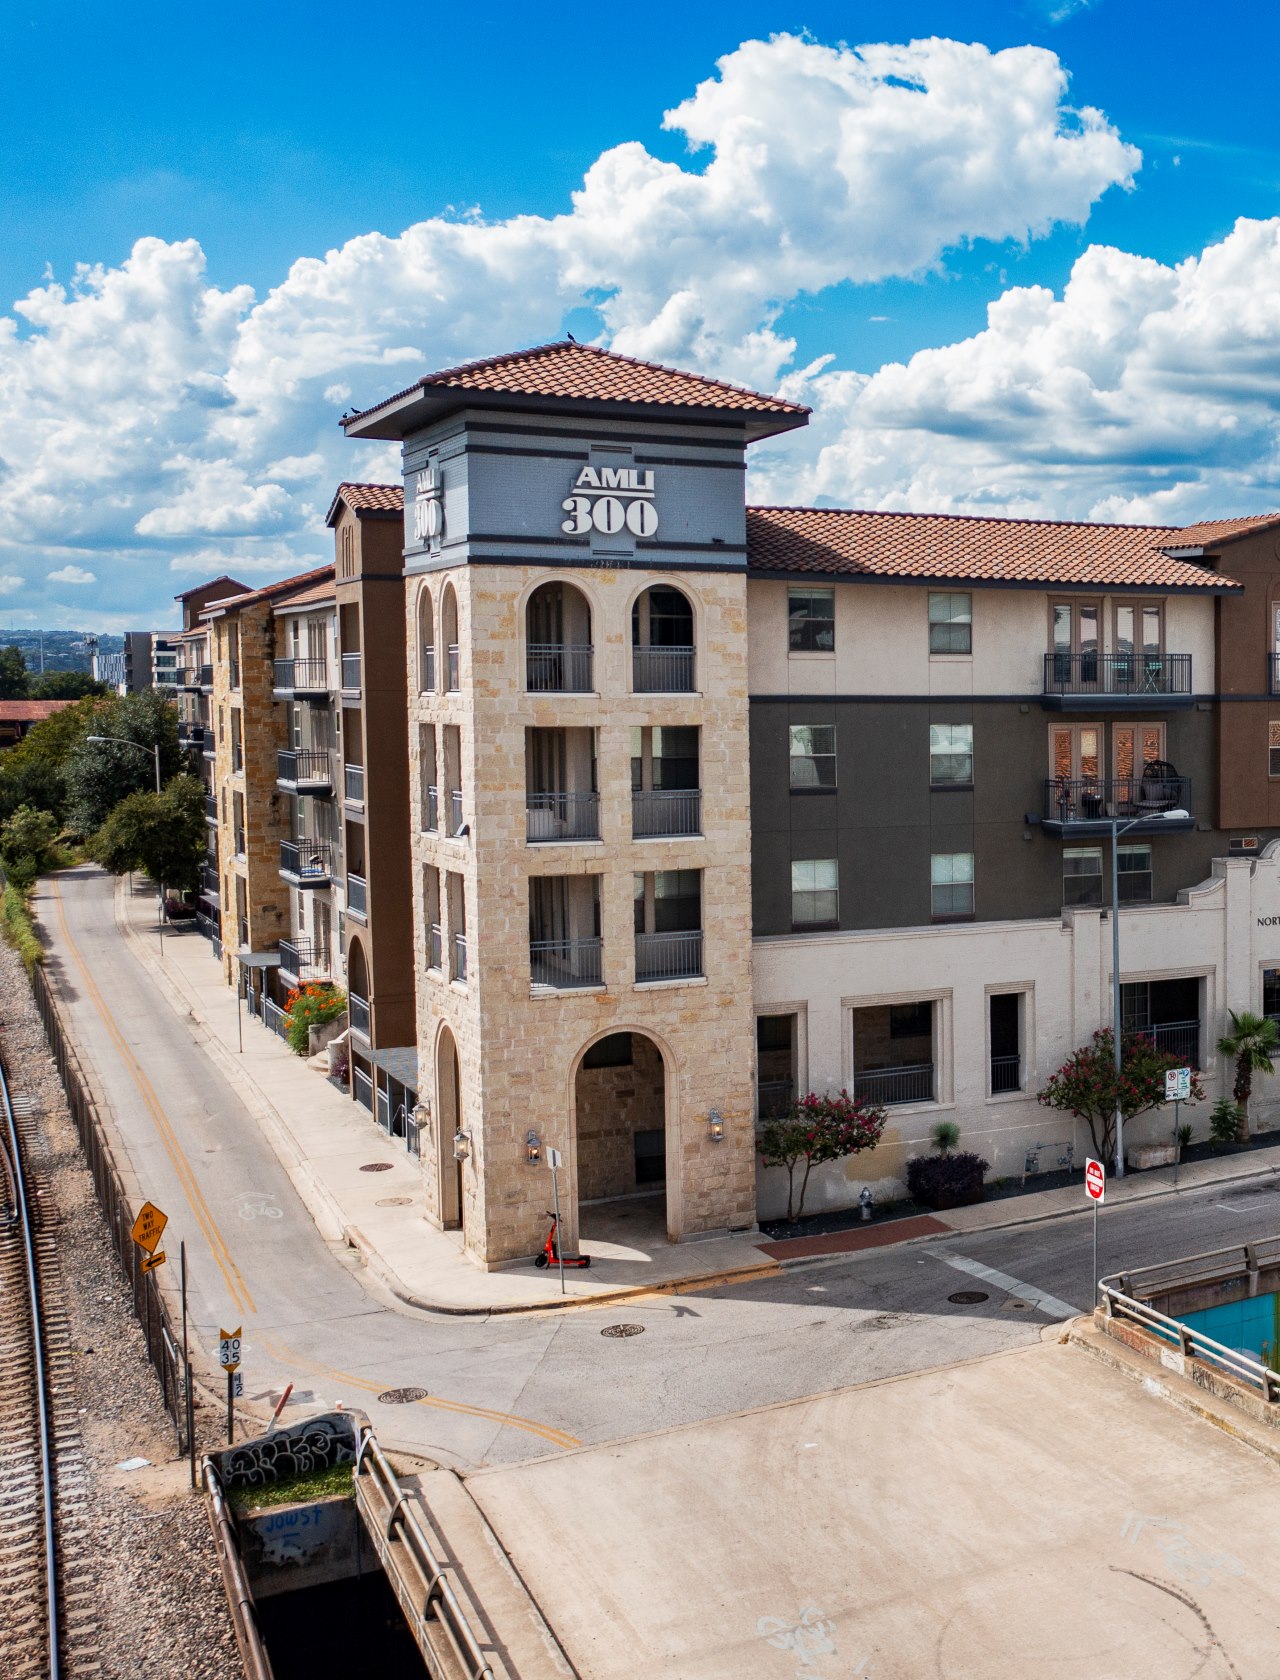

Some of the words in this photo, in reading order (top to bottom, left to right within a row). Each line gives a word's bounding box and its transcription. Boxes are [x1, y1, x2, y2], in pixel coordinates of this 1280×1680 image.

[416, 468, 440, 494] AMLI
[576, 466, 655, 490] AMLI
[414, 498, 441, 540] 300
[561, 496, 659, 537] 300
[142, 1210, 154, 1221] TWO
[138, 1225, 162, 1242] TRAFFIC
[143, 1220, 154, 1231] WAY
[221, 1339, 241, 1350] 40
[221, 1352, 241, 1364] 35
